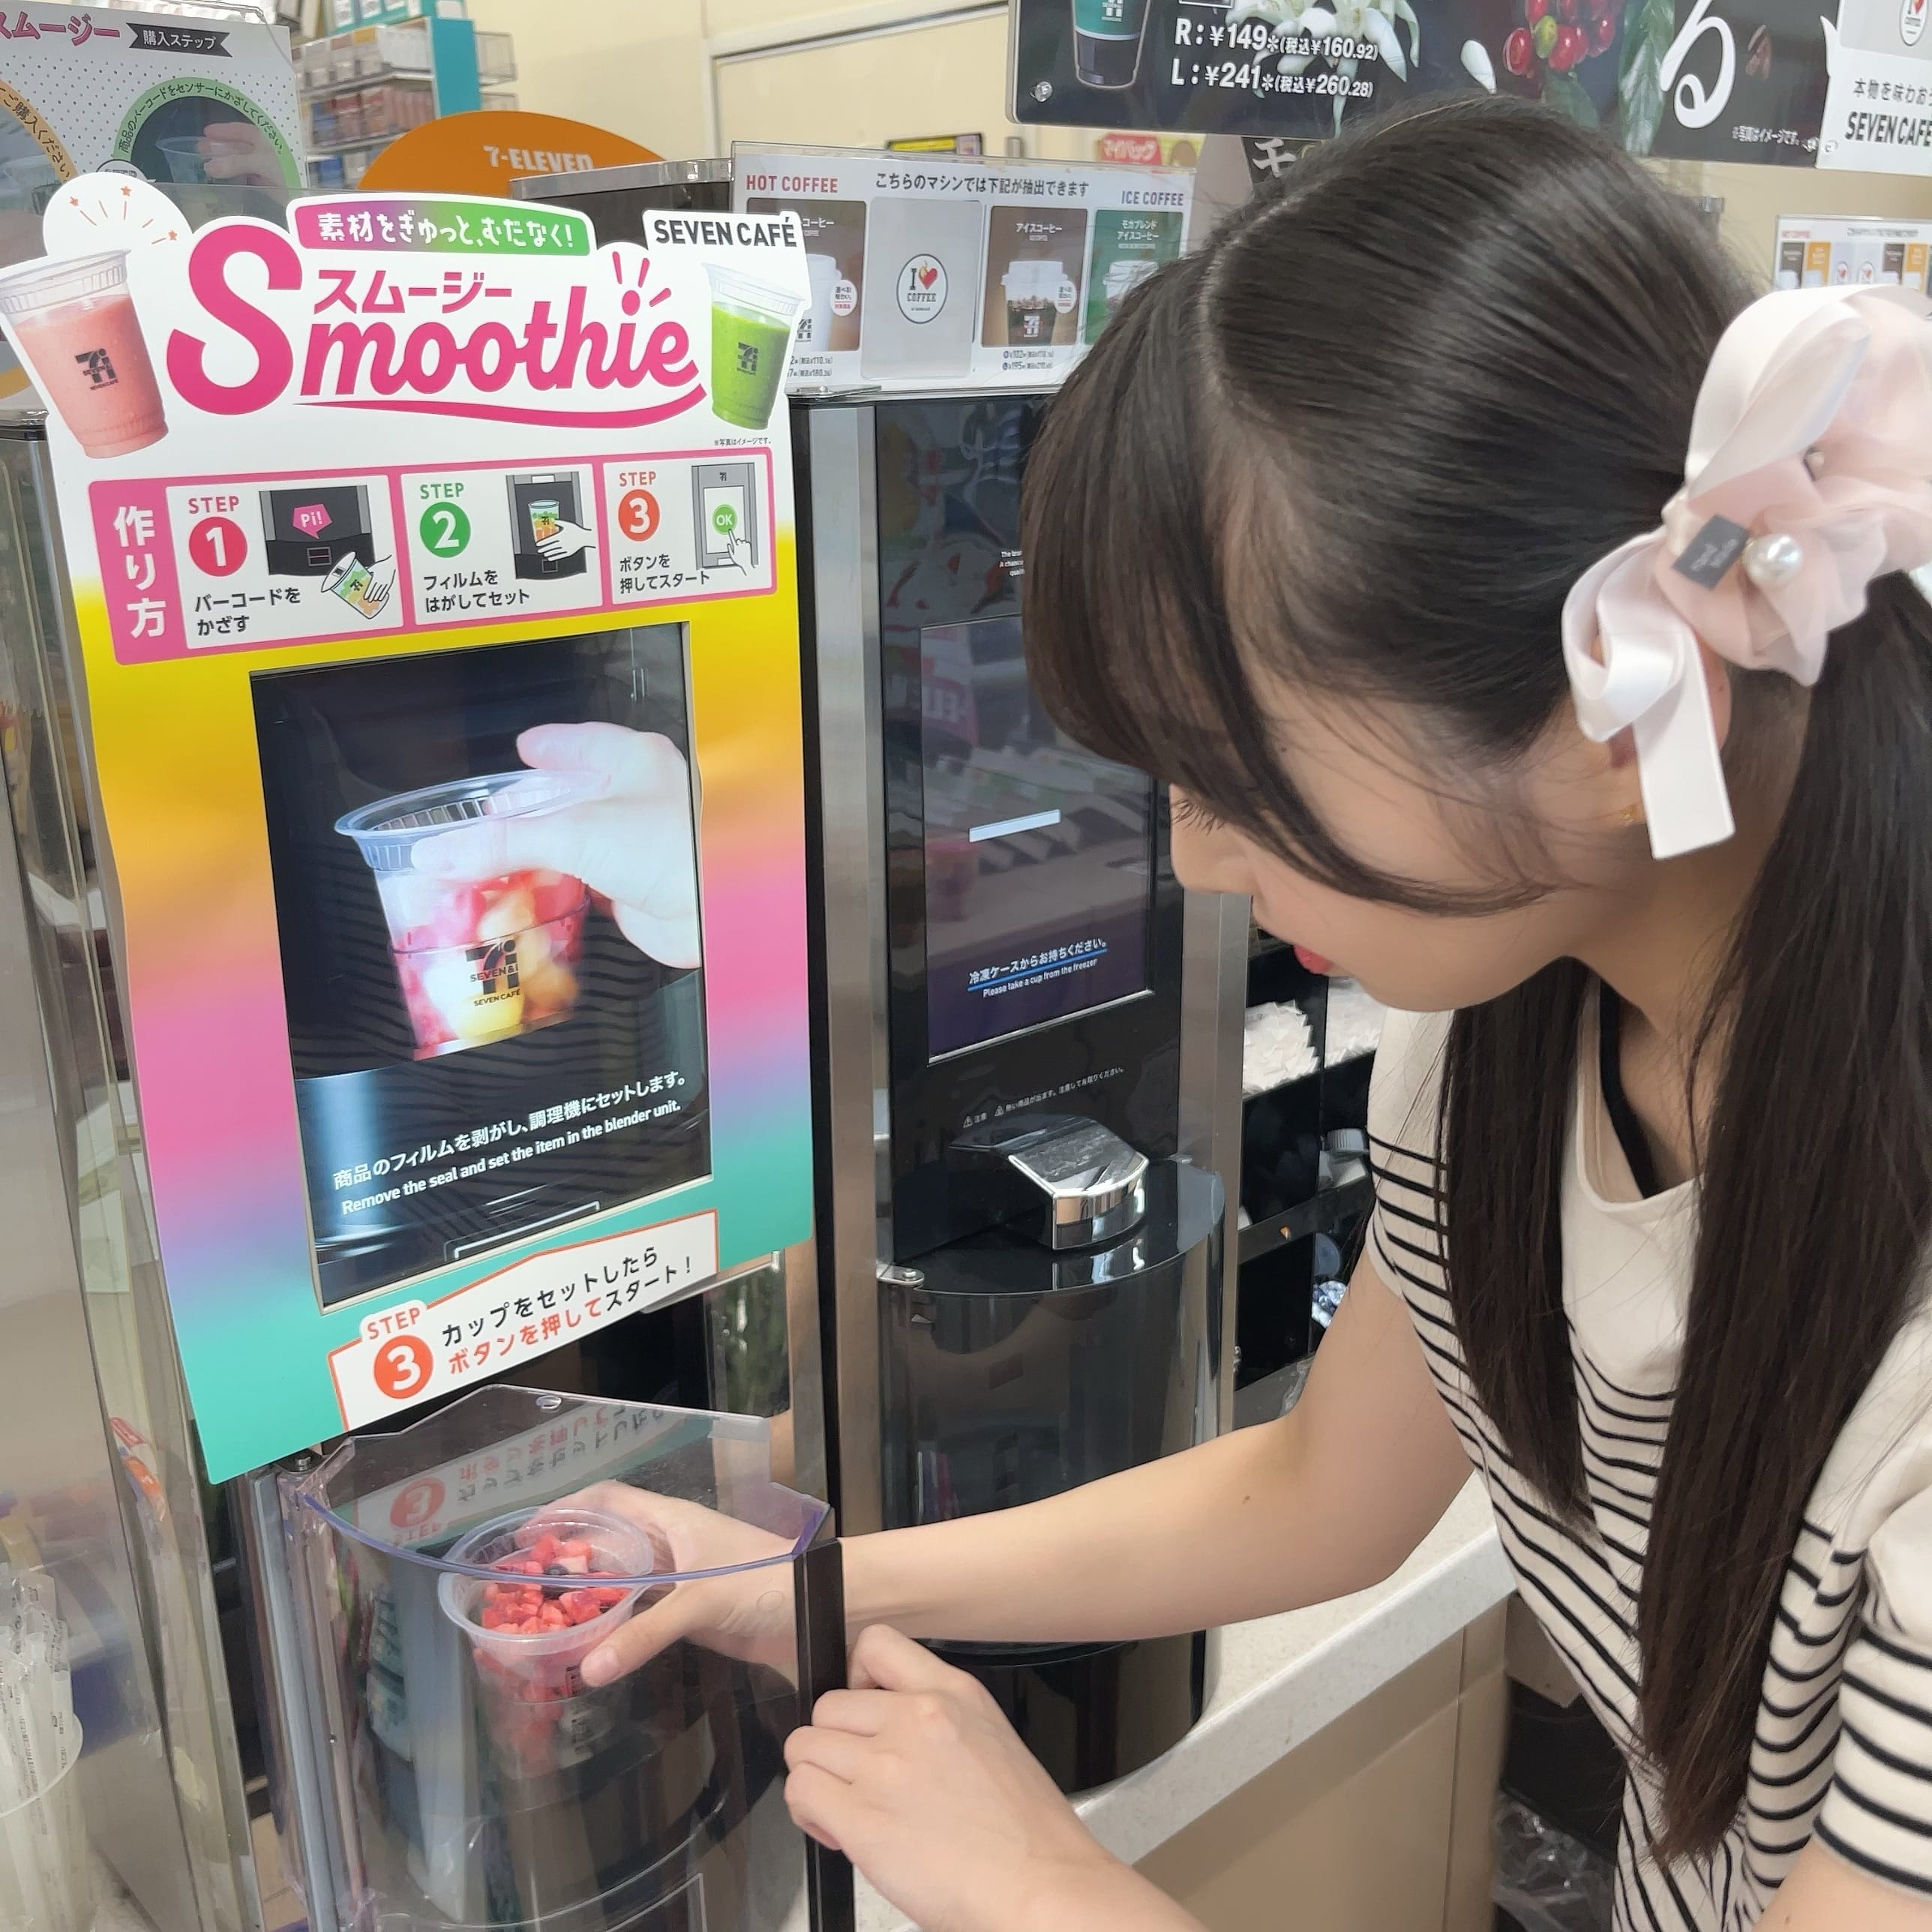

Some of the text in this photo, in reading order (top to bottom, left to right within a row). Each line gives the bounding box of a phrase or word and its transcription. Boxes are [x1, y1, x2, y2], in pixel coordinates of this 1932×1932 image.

[142, 30, 217, 50] 購入ステップ
[1845, 111, 1898, 145] SEVEN
[746, 175, 838, 194] HOT COFFEE
[875, 172, 1089, 197] こちらのマシンでは下記が抽出できます
[1121, 190, 1184, 207] ICE COFFEE
[654, 216, 797, 248] SEVEN CAFÉ
[802, 218, 835, 229] コーヒー
[314, 269, 512, 315] スムージー
[907, 292, 937, 302] COFFEE
[166, 224, 699, 415] Smoothie
[419, 482, 465, 500] STEP
[619, 471, 657, 487] STEP
[188, 496, 240, 514] STEP
[300, 508, 323, 527] Pi!
[628, 496, 650, 534] 3
[431, 510, 460, 550] 2
[716, 513, 733, 526] OK
[205, 526, 227, 568] 1
[113, 506, 166, 639] 作り方
[620, 553, 671, 573] ボタンを
[423, 568, 499, 590] フィルムを
[620, 570, 711, 595] 押してスタート
[195, 586, 302, 613] バーコードを
[425, 588, 530, 614] はがしてセット
[197, 614, 250, 637] かざす
[968, 938, 1108, 985] 冷凍ケースからお持ちください。
[982, 958, 1099, 999] Please take a cup from the freezer
[332, 1070, 687, 1191] 商品のフィルムを剥がし、調理機にセットします。
[342, 1099, 682, 1215] Remove the seal and set the item in the blender unit.
[442, 1246, 659, 1348] カップをセットしたら
[367, 1307, 422, 1341] STEP
[387, 1344, 421, 1391] 3
